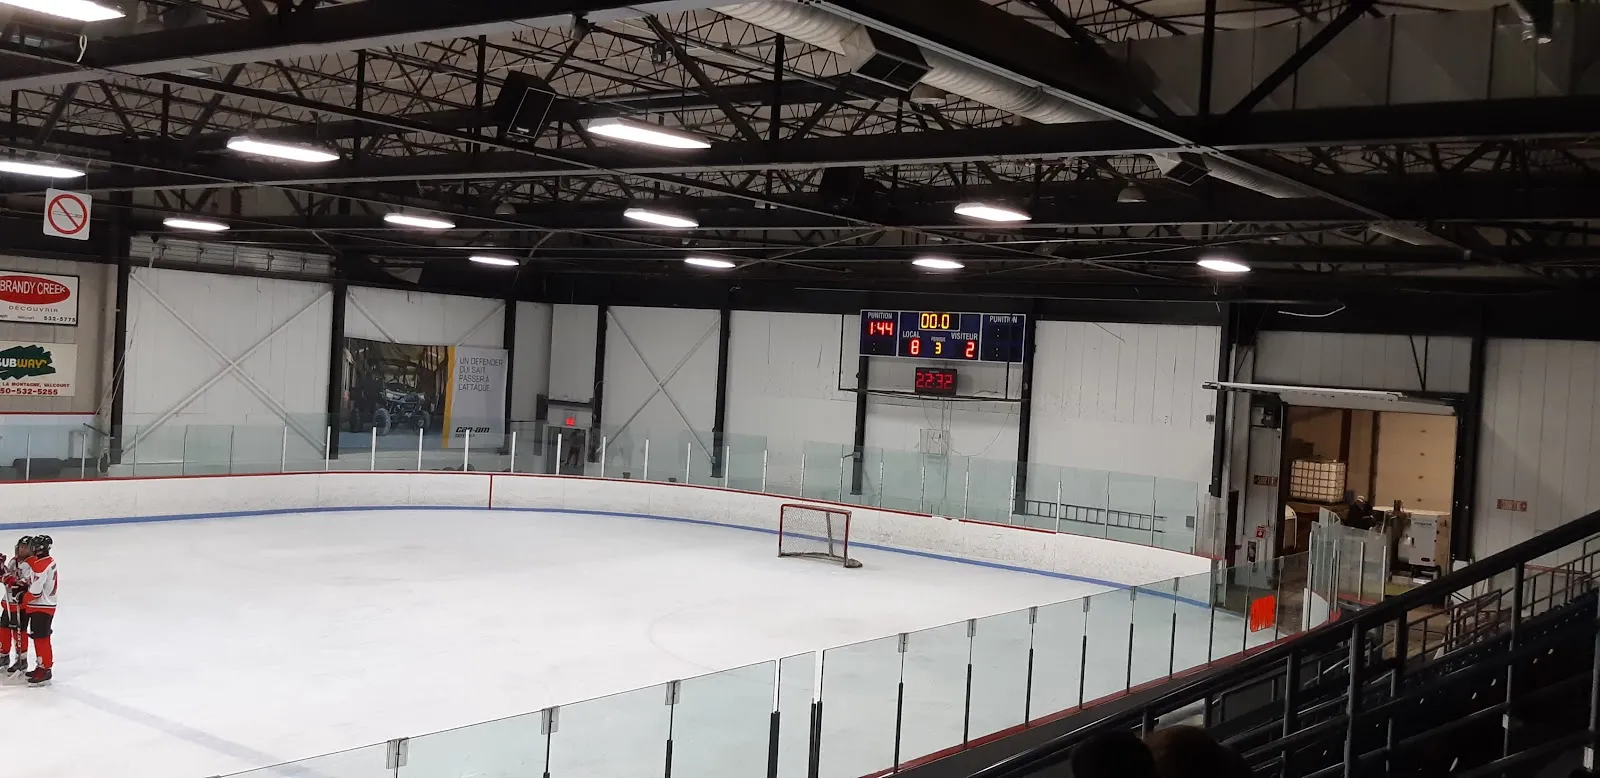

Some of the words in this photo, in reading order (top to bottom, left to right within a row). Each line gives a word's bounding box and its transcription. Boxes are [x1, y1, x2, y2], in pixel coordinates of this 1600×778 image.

[0, 280, 36, 294] BRANDY
[37, 282, 66, 295] CREEK
[867, 311, 893, 320] PUNITION
[920, 313, 950, 329] 00.0
[870, 321, 894, 336] 1:44
[902, 330, 921, 338] LOCAL
[911, 339, 920, 355] 8
[935, 341, 942, 355] 3
[965, 341, 975, 358] 2
[460, 357, 469, 365] UN
[470, 357, 503, 367] DEFENDER
[471, 366, 486, 375] SAIT
[459, 374, 485, 383] PASSER
[916, 372, 953, 389] 22:32
